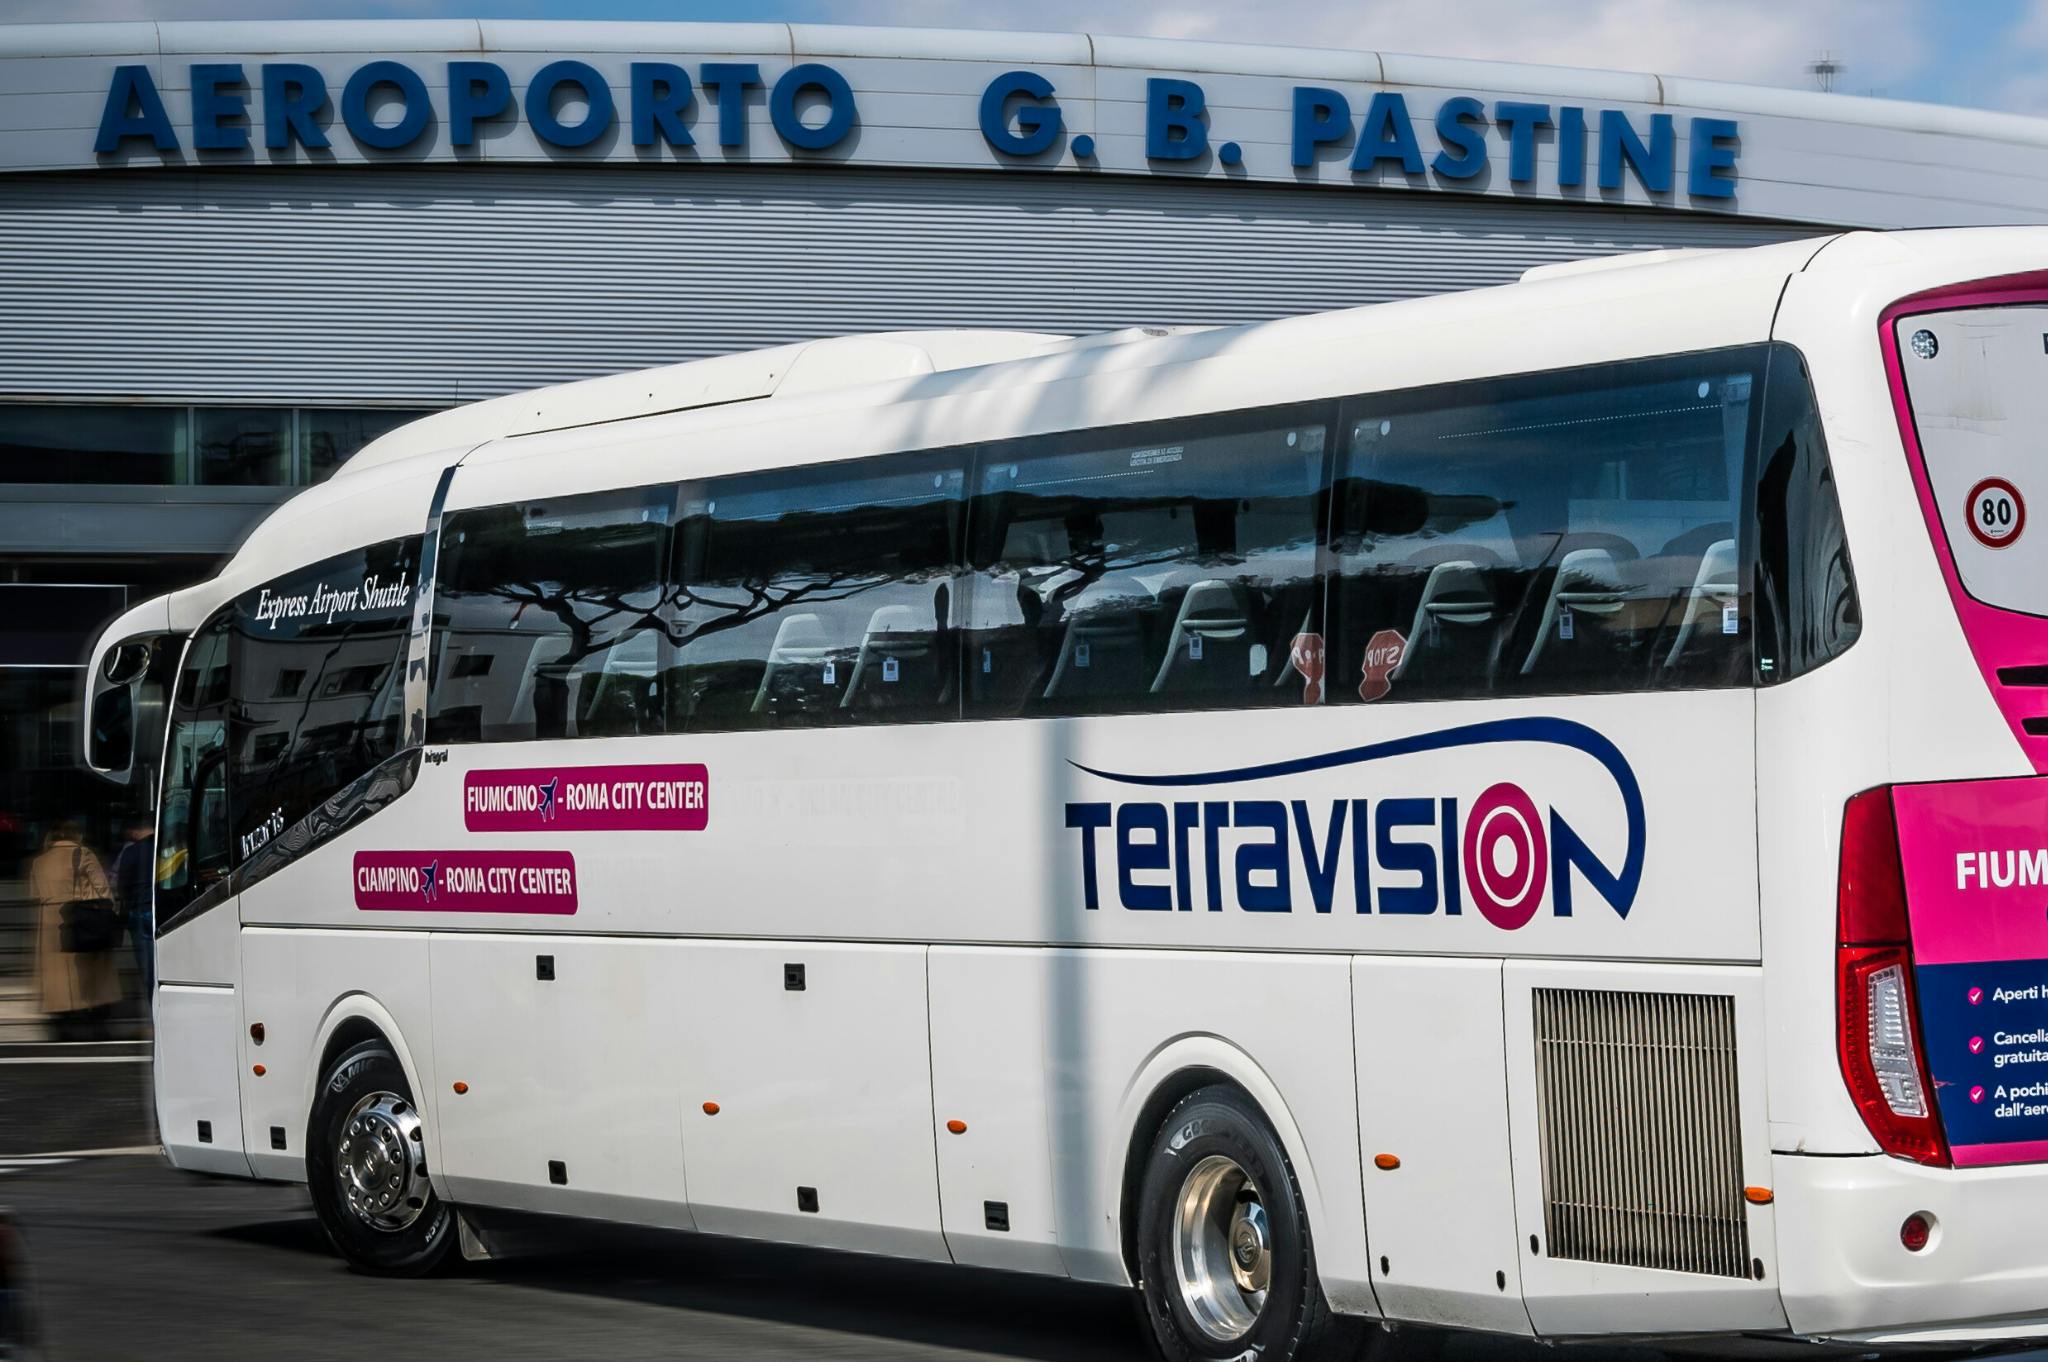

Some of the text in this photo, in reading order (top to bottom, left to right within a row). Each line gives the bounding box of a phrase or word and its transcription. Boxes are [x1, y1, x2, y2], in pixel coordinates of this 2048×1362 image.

[94, 60, 1738, 197] AEROPORTO G. B. PASTINE
[1982, 498, 2011, 526] 80
[255, 572, 410, 630] Express Airport Shuttle
[468, 785, 537, 812] FIUMICINO
[566, 783, 609, 810] ROMA
[612, 782, 644, 810] CITY
[646, 781, 704, 809] CENTER
[358, 866, 419, 893] CIAMPINO
[446, 867, 486, 893] ROMA
[488, 868, 517, 893] CITY
[519, 868, 572, 894] CENTER
[1956, 849, 2048, 889] FIUM
[1993, 986, 2038, 1004] Aperti
[1994, 1082, 2048, 1101] A pochi
[1994, 1102, 2048, 1118] dall'aer
